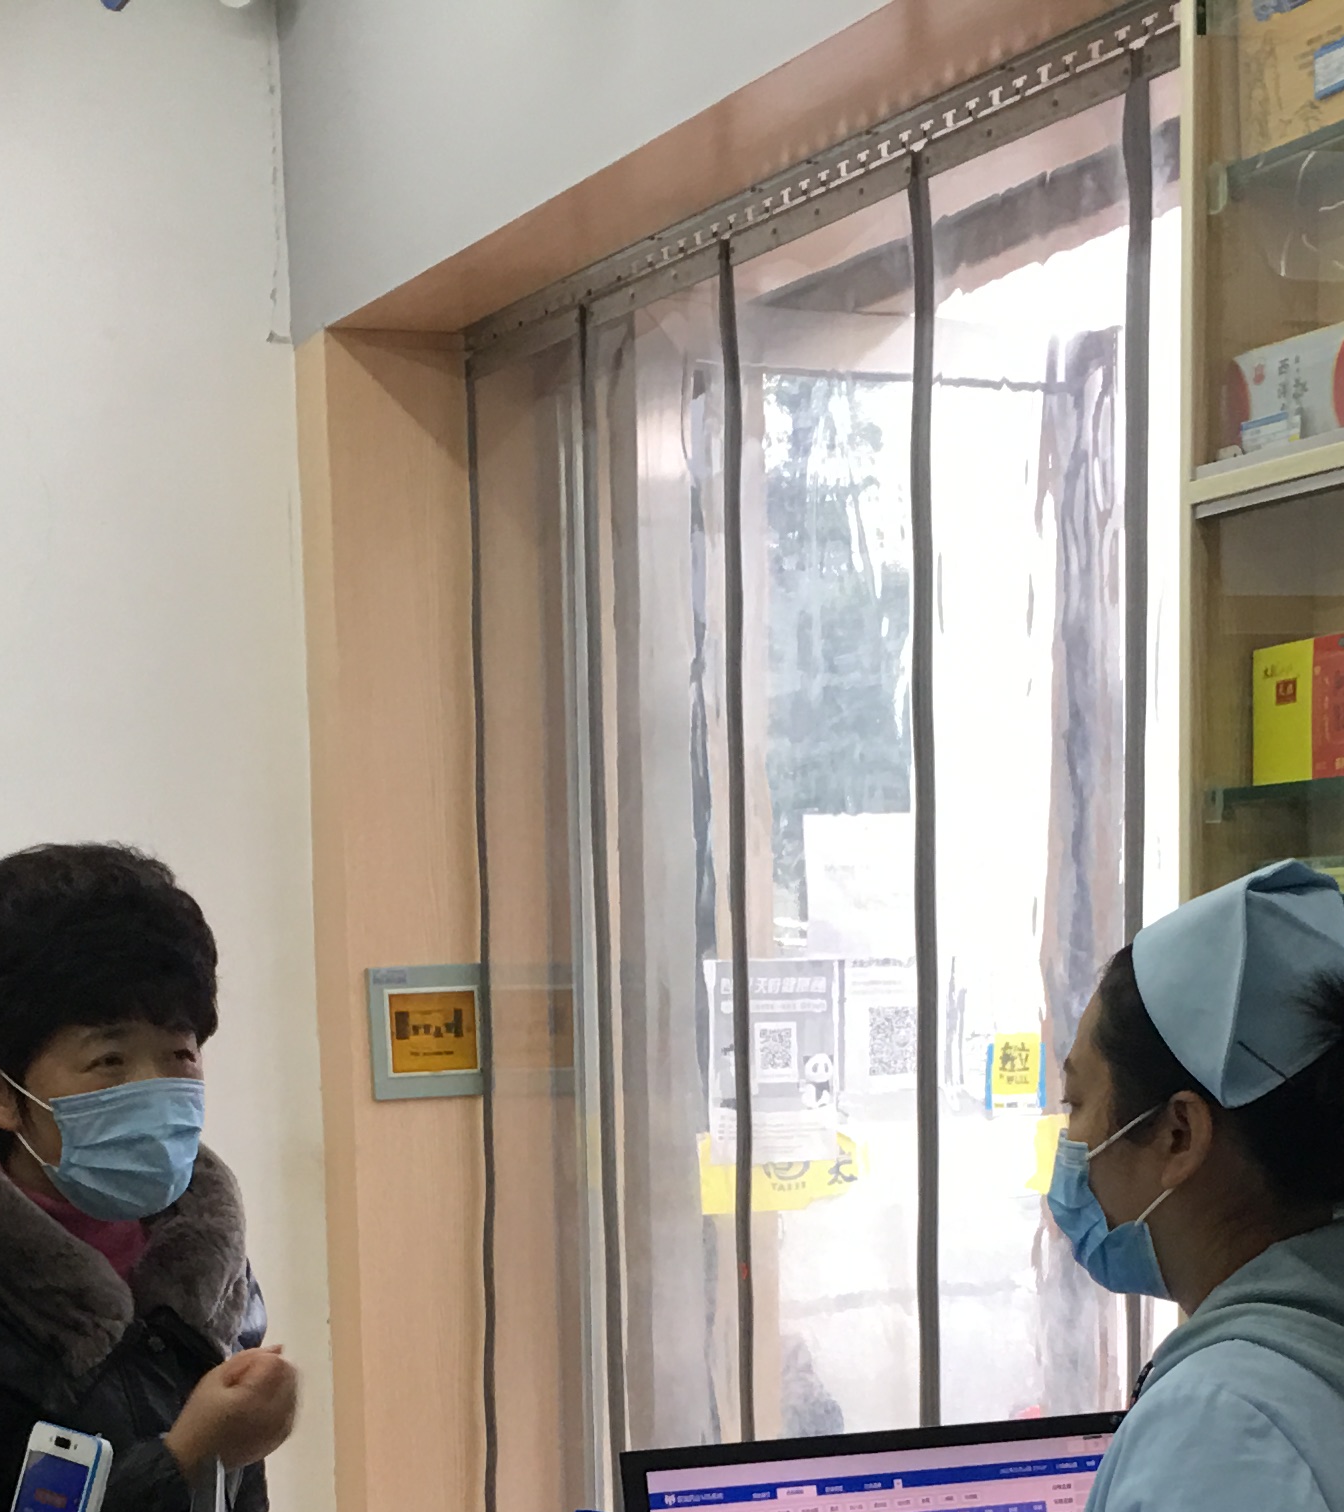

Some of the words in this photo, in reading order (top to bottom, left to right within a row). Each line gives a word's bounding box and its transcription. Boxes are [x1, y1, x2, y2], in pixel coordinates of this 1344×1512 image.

[720, 976, 827, 995] 四天府健康通
